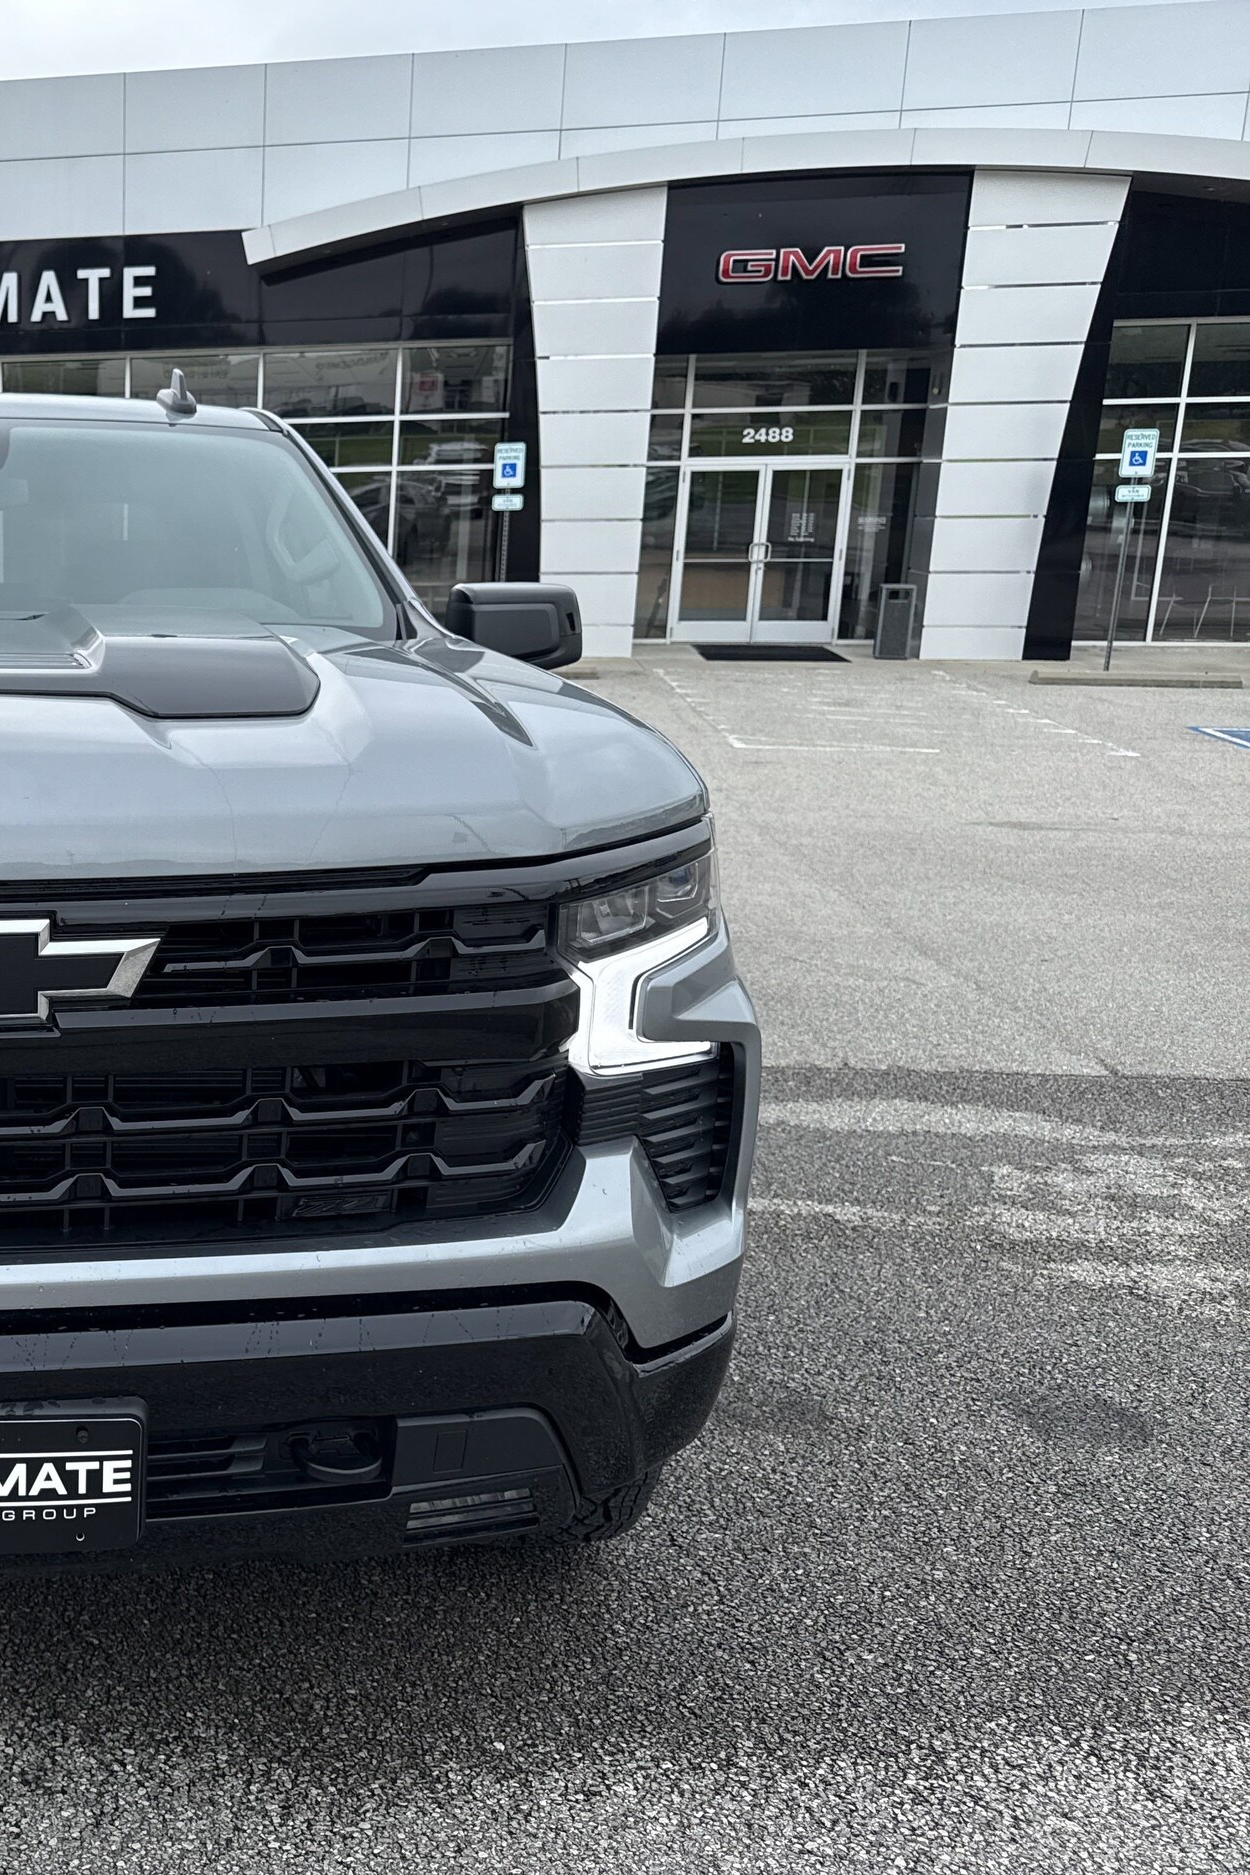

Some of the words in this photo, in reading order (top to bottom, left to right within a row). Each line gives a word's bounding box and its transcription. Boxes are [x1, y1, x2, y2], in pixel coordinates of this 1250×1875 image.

[718, 243, 906, 282] GMC
[741, 426, 794, 444] 2488
[1126, 433, 1156, 441] RESERVED
[1127, 441, 1154, 449] PARKING
[1, 1507, 97, 1521] GROUP
